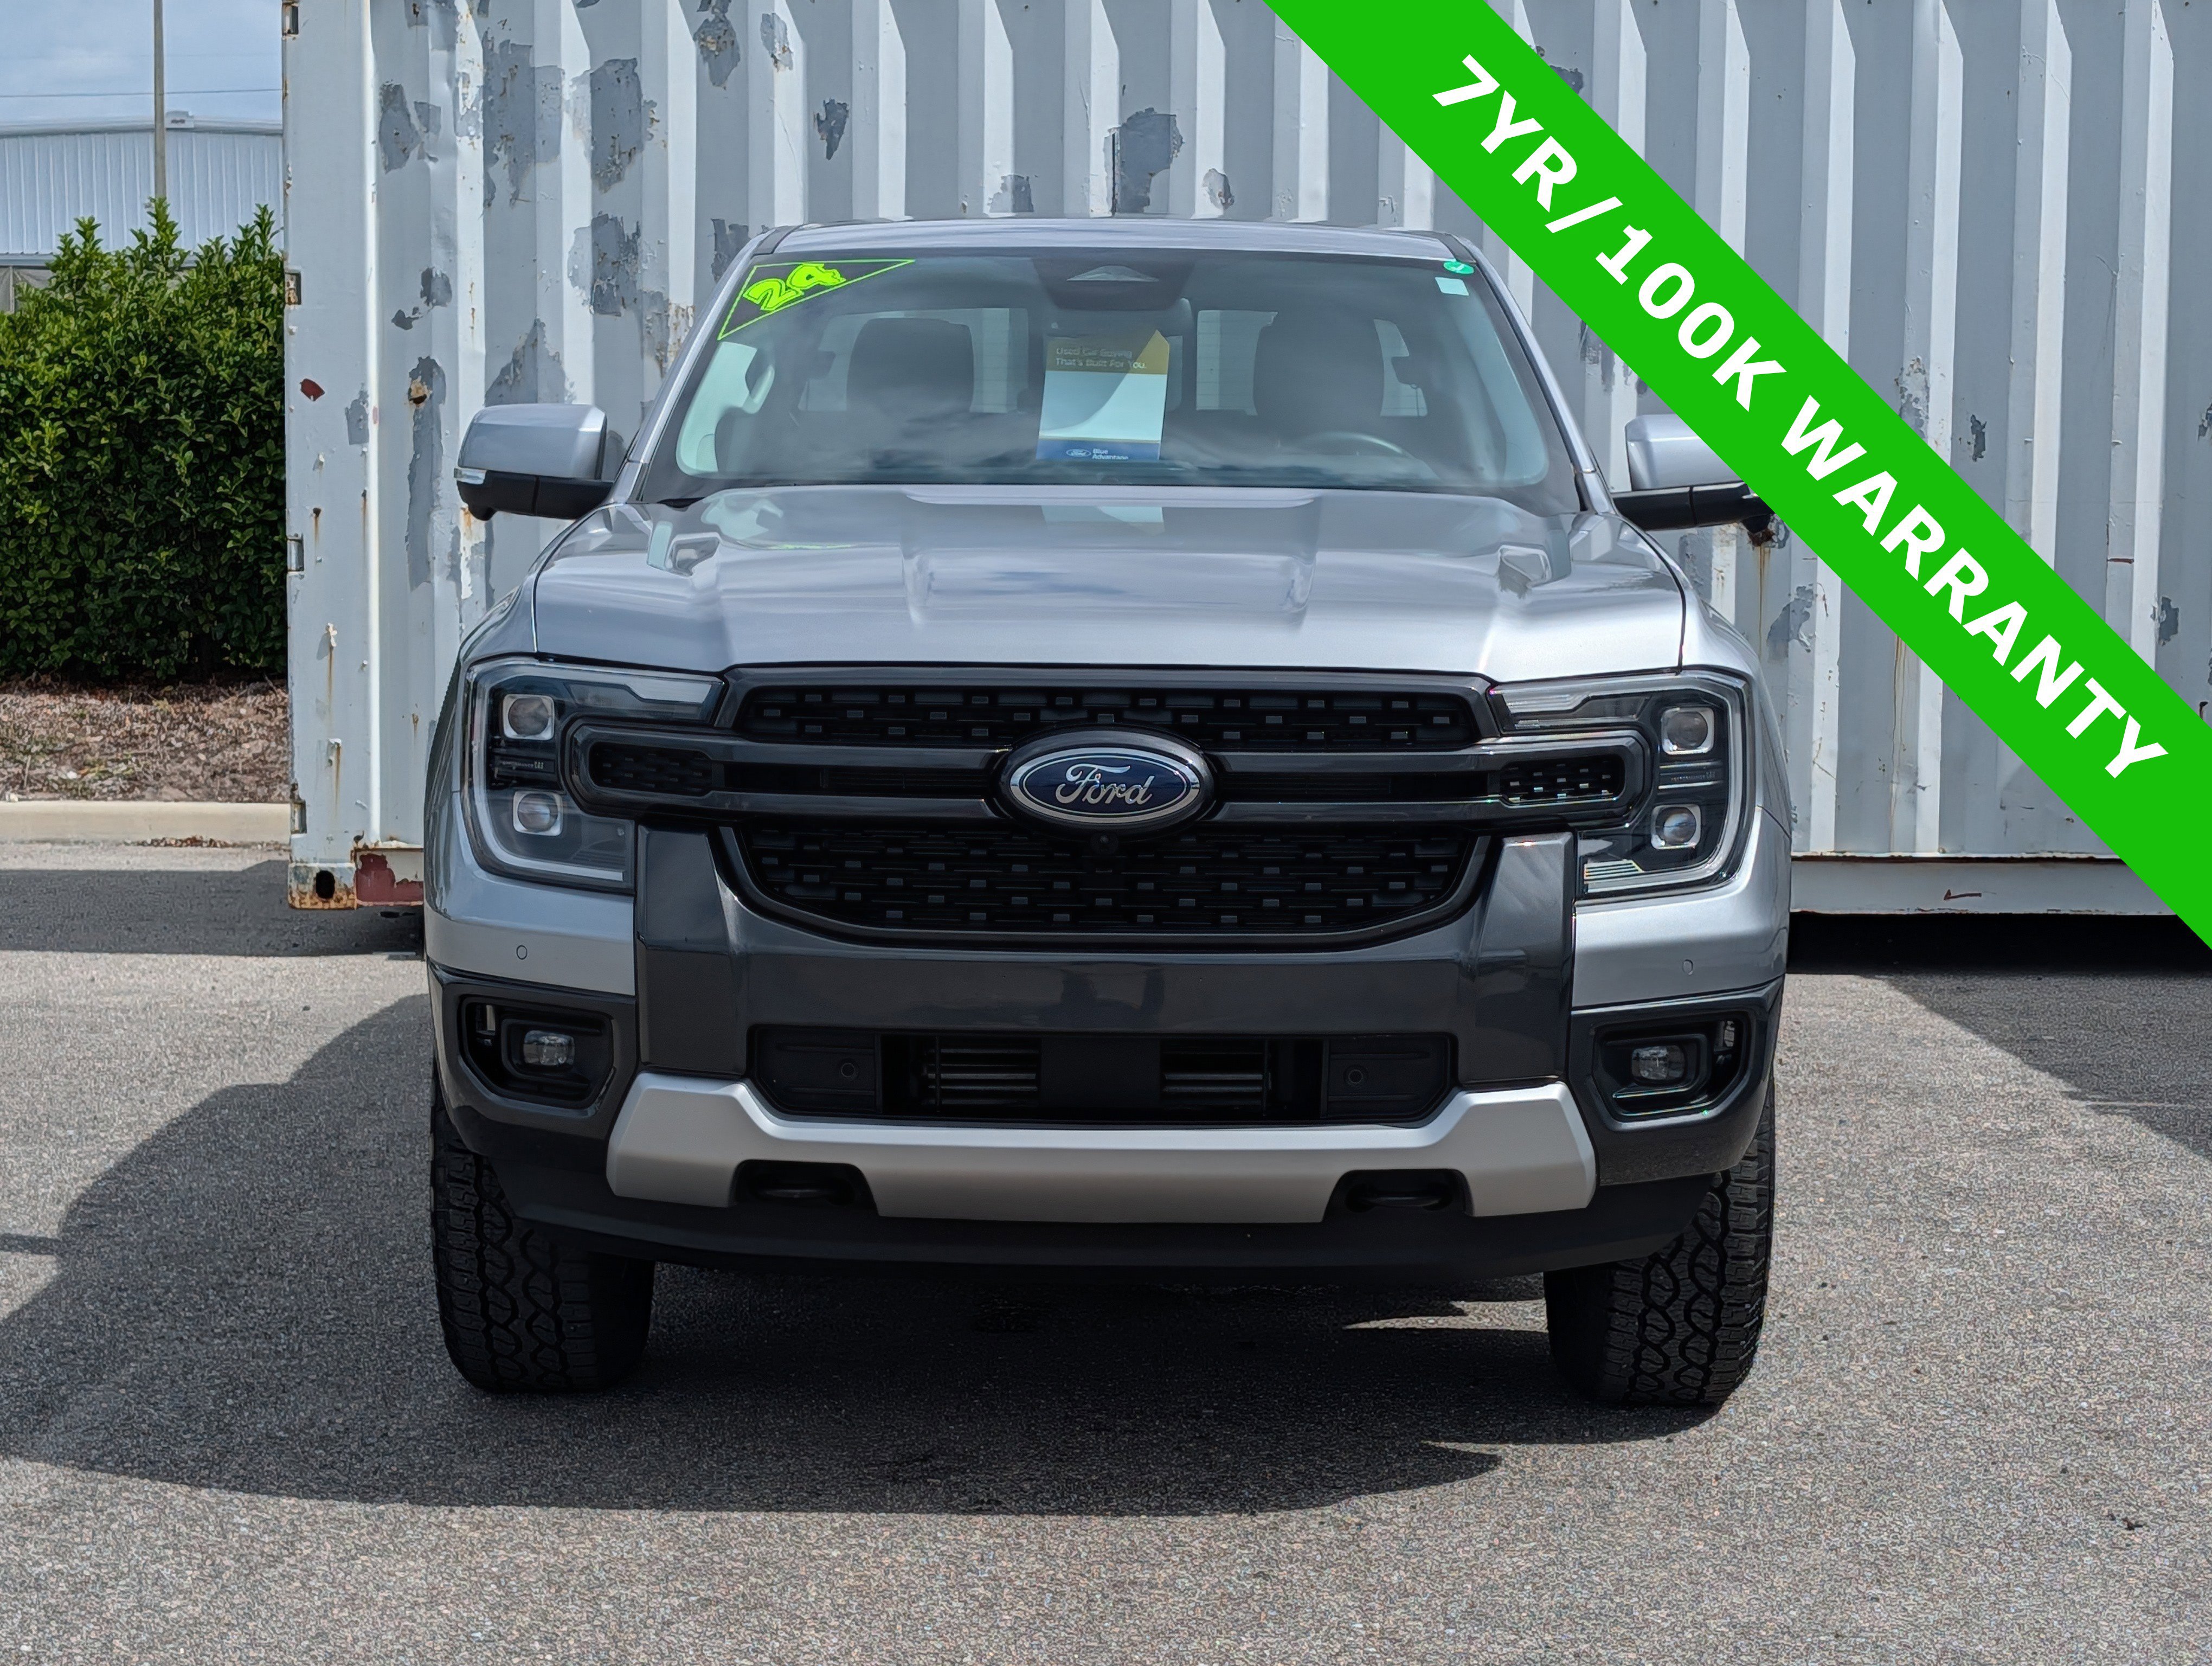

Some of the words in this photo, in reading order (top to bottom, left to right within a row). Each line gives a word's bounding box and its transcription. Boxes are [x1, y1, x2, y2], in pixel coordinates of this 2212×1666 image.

[1056, 348, 1079, 356] Used
[1056, 357, 1083, 367] That's
[1109, 359, 1124, 368] For
[1055, 762, 1155, 804] Ford
